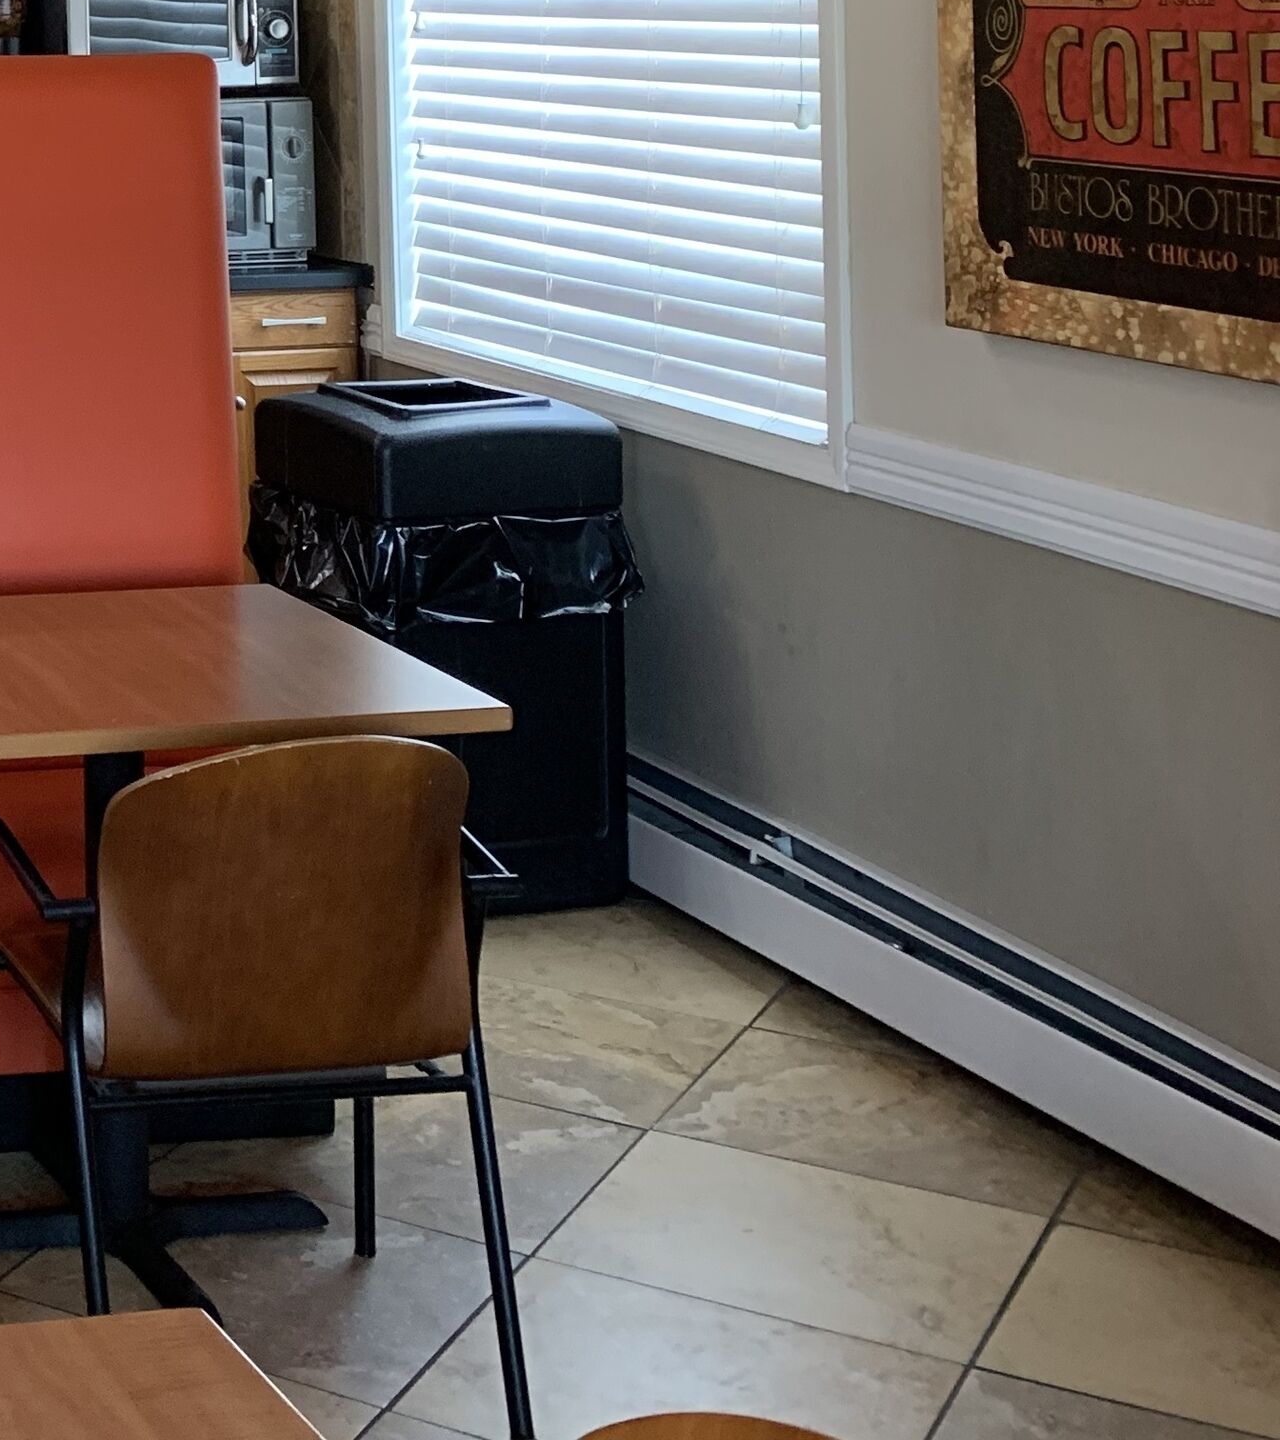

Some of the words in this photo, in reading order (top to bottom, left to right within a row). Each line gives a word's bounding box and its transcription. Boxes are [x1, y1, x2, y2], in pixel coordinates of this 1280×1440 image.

[1030, 172, 1133, 222] BUSTOS
[1147, 183, 1280, 241] BROTHE
[1028, 225, 1066, 249] NEW
[1073, 231, 1124, 258] YORK
[1148, 242, 1238, 272] CHICAGO
